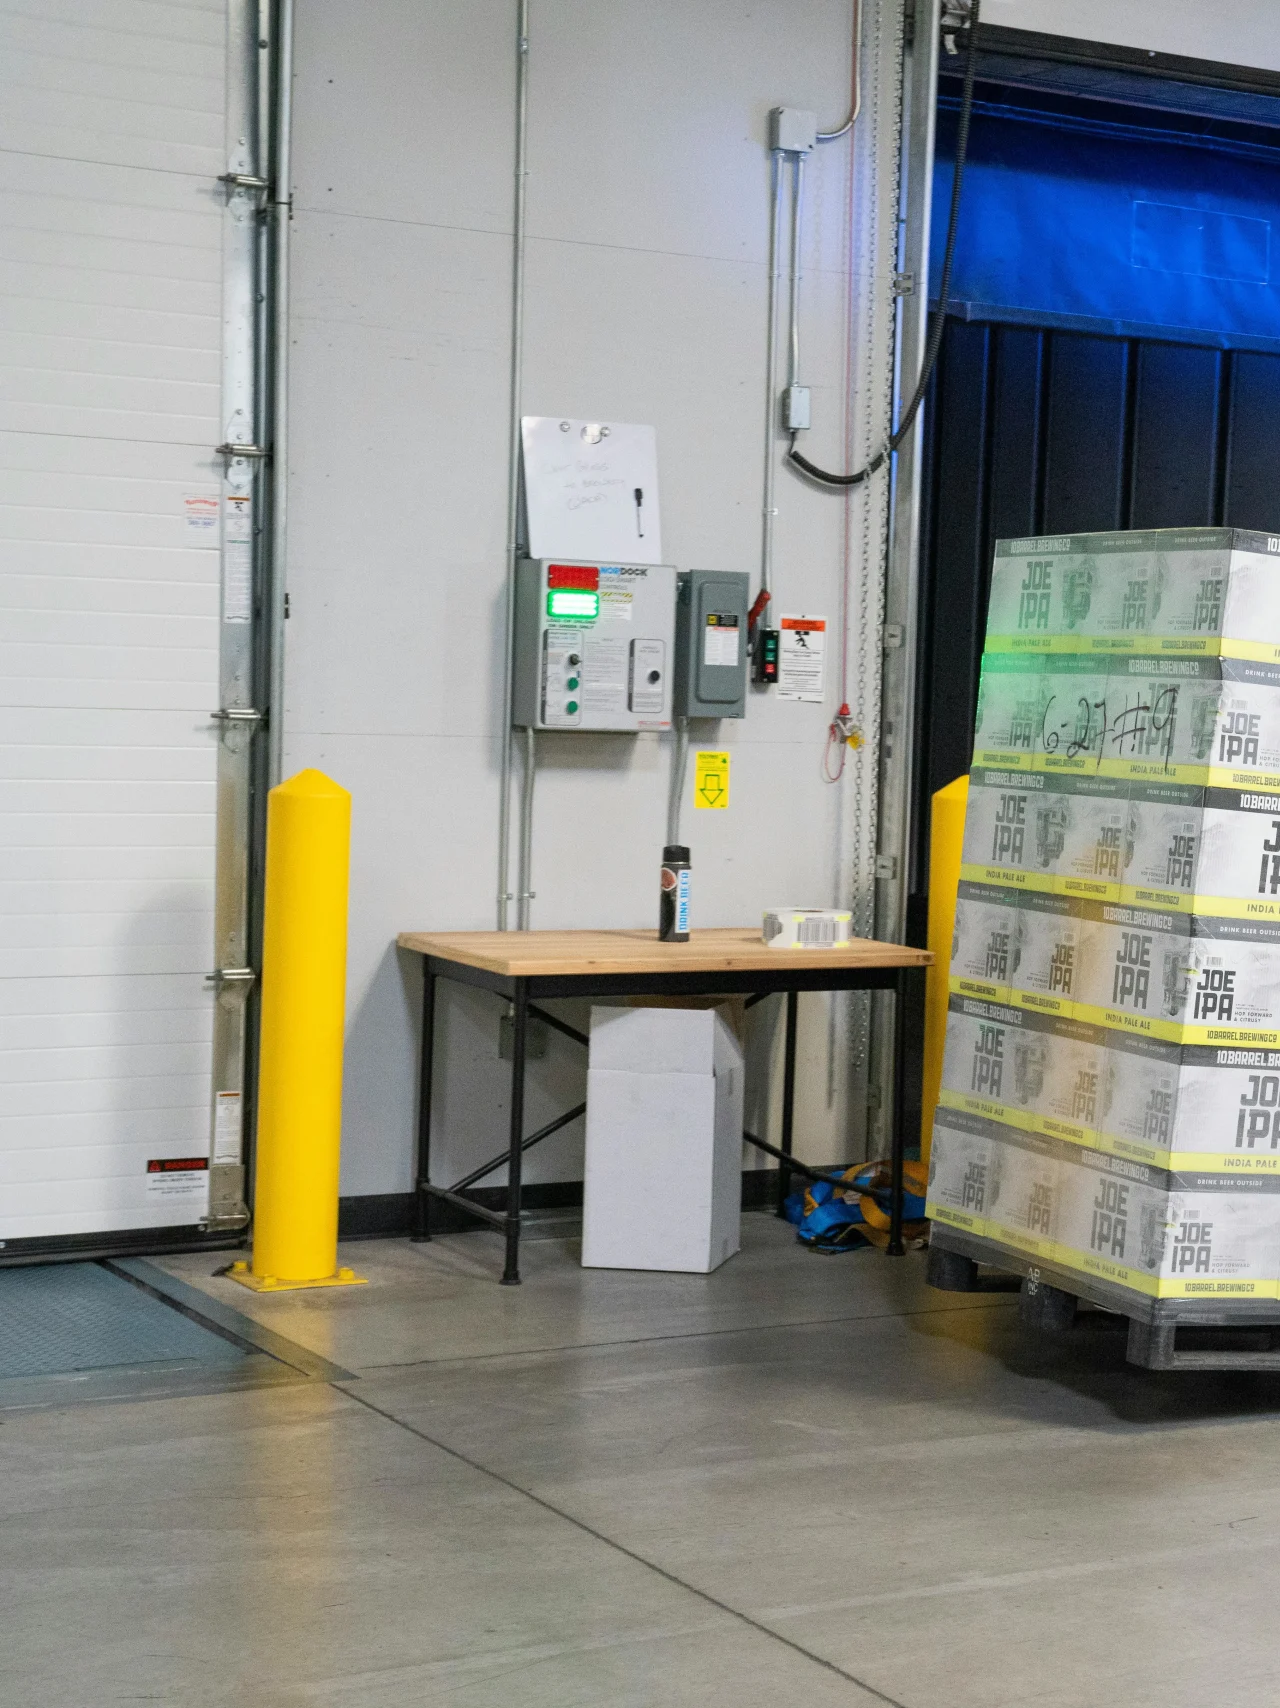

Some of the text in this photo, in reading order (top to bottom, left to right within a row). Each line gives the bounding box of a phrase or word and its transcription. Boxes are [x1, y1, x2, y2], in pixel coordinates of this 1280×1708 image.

[1021, 560, 1053, 591] JOE
[1196, 580, 1223, 602] JOE
[1018, 592, 1051, 629] IPA
[1192, 603, 1220, 631] IPA
[1244, 669, 1265, 678] DRINK
[1222, 711, 1261, 737] JOE
[1219, 734, 1259, 765] IPA
[995, 794, 1028, 825] JOE
[991, 824, 1025, 864] IPA
[1096, 826, 1122, 849] JOE
[1168, 835, 1195, 859] JOE
[985, 870, 1026, 883] INDIA PALE ALE
[1093, 849, 1120, 877] IPA
[1166, 858, 1194, 888] IPA
[1247, 903, 1275, 914] INDIA
[987, 931, 1010, 954] JOE
[1220, 926, 1241, 934] DRINK
[1051, 943, 1075, 967] JOE
[1116, 932, 1153, 968] JOE
[985, 953, 1008, 981] IPA
[1049, 964, 1072, 994] IPA
[1197, 969, 1236, 992] JOE
[1112, 965, 1150, 1010] IPA
[1194, 992, 1234, 1021] IPA
[1105, 1013, 1151, 1030] INDIA PALE ALE
[975, 1024, 1005, 1059] JOE
[971, 1055, 1003, 1098] IPA
[1146, 1089, 1172, 1116] JOE
[1143, 1112, 1169, 1144] IPA
[1224, 1158, 1252, 1167] INDIA
[1256, 1160, 1277, 1168] PALE
[1094, 1178, 1129, 1218] JOE
[1090, 1209, 1127, 1259] IPA
[1174, 1222, 1213, 1245] JOE
[1171, 1245, 1211, 1273] IPA
